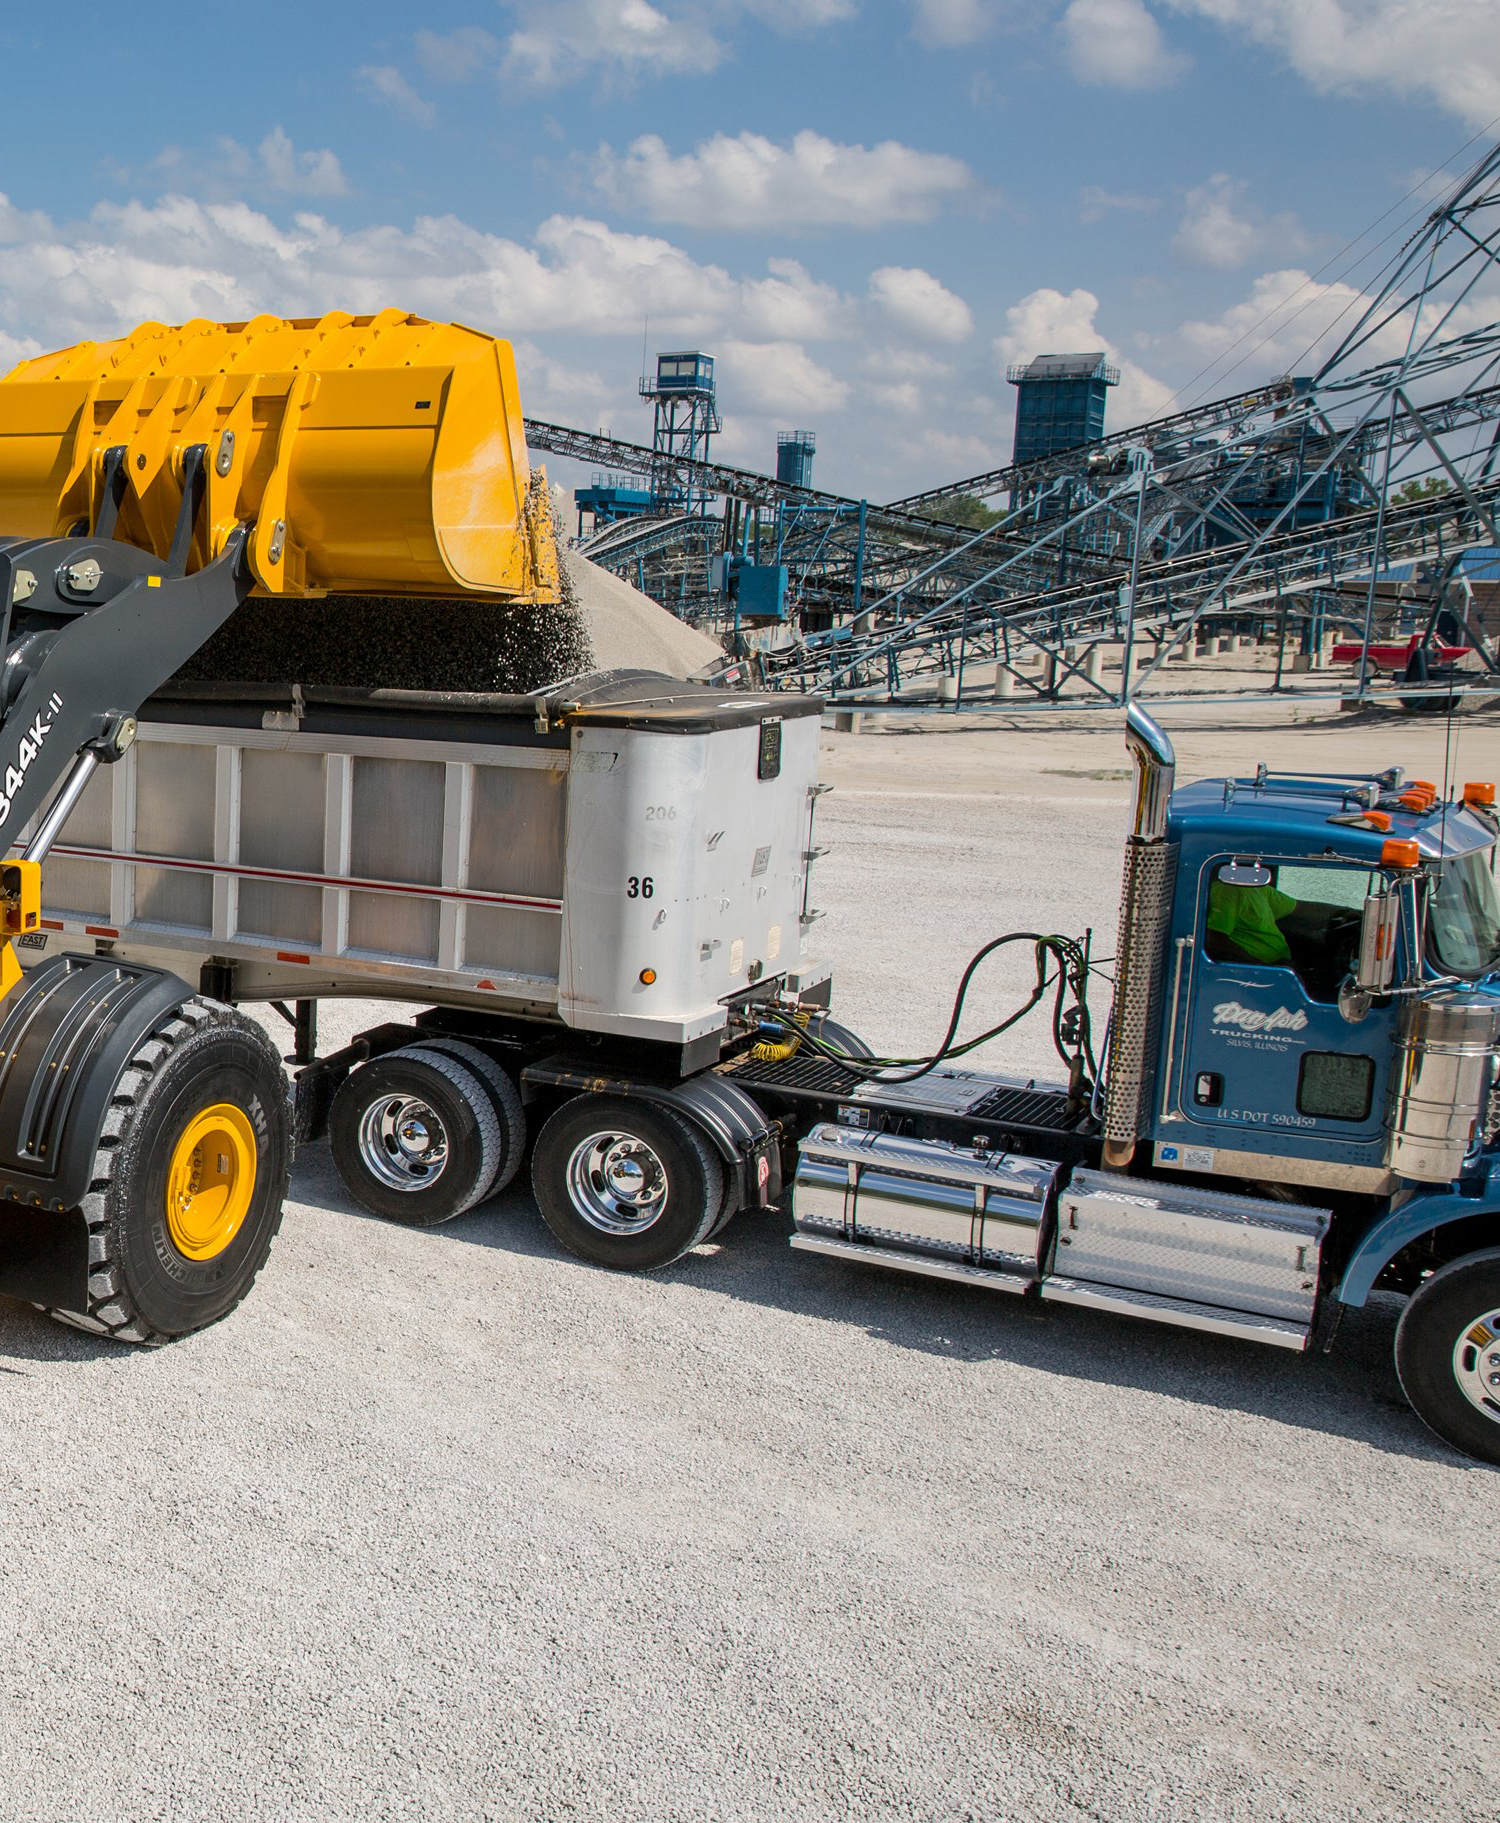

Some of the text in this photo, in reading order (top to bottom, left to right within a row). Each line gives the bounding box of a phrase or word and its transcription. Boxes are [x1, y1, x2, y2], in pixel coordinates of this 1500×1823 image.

[645, 806, 677, 821] 206
[627, 876, 654, 899] 36
[22, 935, 44, 946] EAST
[1209, 1028, 1293, 1043] TRUCKING
[1226, 1039, 1252, 1049] SILVIS,
[1254, 1041, 1288, 1052] ILLINOIS
[1230, 1109, 1240, 1120] S
[1242, 1110, 1270, 1123] DOT
[1271, 1113, 1316, 1128] 590459
